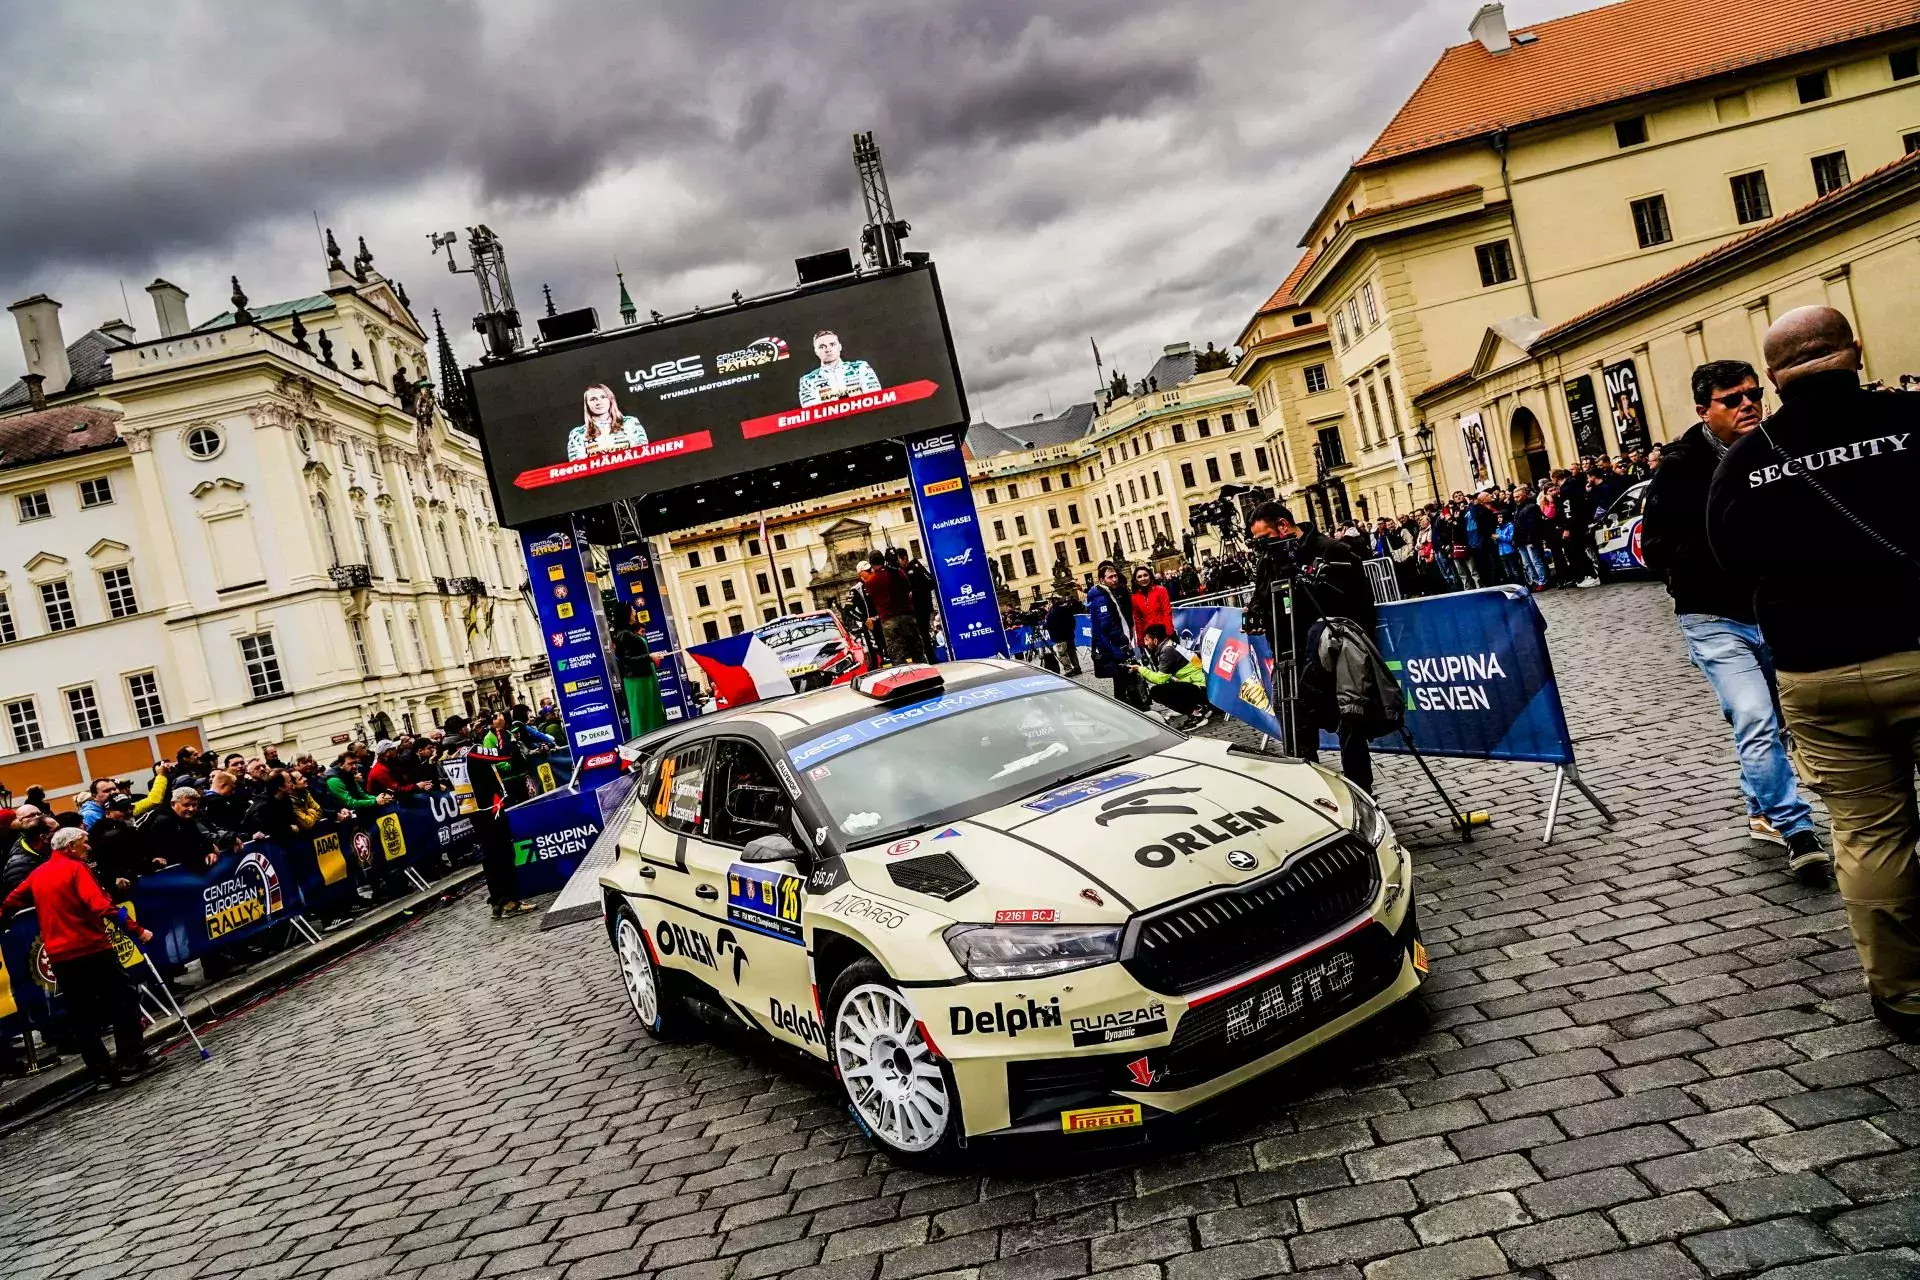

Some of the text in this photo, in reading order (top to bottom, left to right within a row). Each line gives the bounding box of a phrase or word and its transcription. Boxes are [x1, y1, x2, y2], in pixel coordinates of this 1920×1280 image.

[716, 347, 757, 361] CENTRAL
[717, 350, 767, 366] EUROPEAN
[719, 357, 761, 374] RALLY
[625, 355, 703, 383] WRC
[660, 386, 697, 401] HYUNDAI
[699, 374, 752, 393] MOTORSPORT
[777, 410, 811, 428] Emil
[812, 390, 897, 419] LINDHOLM
[911, 433, 955, 452] WRC
[549, 463, 588, 479] Reeta
[589, 439, 685, 470] HÄMÄLÄINEN
[1748, 432, 1911, 489] SECURITY
[959, 627, 995, 640] TW STEEL
[568, 652, 597, 663] SKUPINA
[1406, 651, 1507, 684] SKUPINA
[588, 729, 610, 740] DEKRA
[316, 834, 339, 856] ADAC
[535, 823, 599, 848] SKUPINA
[1134, 805, 1285, 868] ORLEN
[203, 875, 247, 902] CENTRAL
[812, 867, 838, 888] sjs.pl
[205, 886, 258, 918] EUROPEAN
[781, 876, 800, 921] 26
[207, 901, 255, 939] RALLY
[1031, 910, 1054, 921] BCJ
[656, 919, 719, 972] ORLEN
[1226, 951, 1355, 1044] KAJTO
[949, 996, 1062, 1038] Delphi
[1070, 1003, 1166, 1034] QUAZAR
[1104, 1026, 1136, 1042] Dynamic
[1069, 1107, 1136, 1131] PIRELLI
